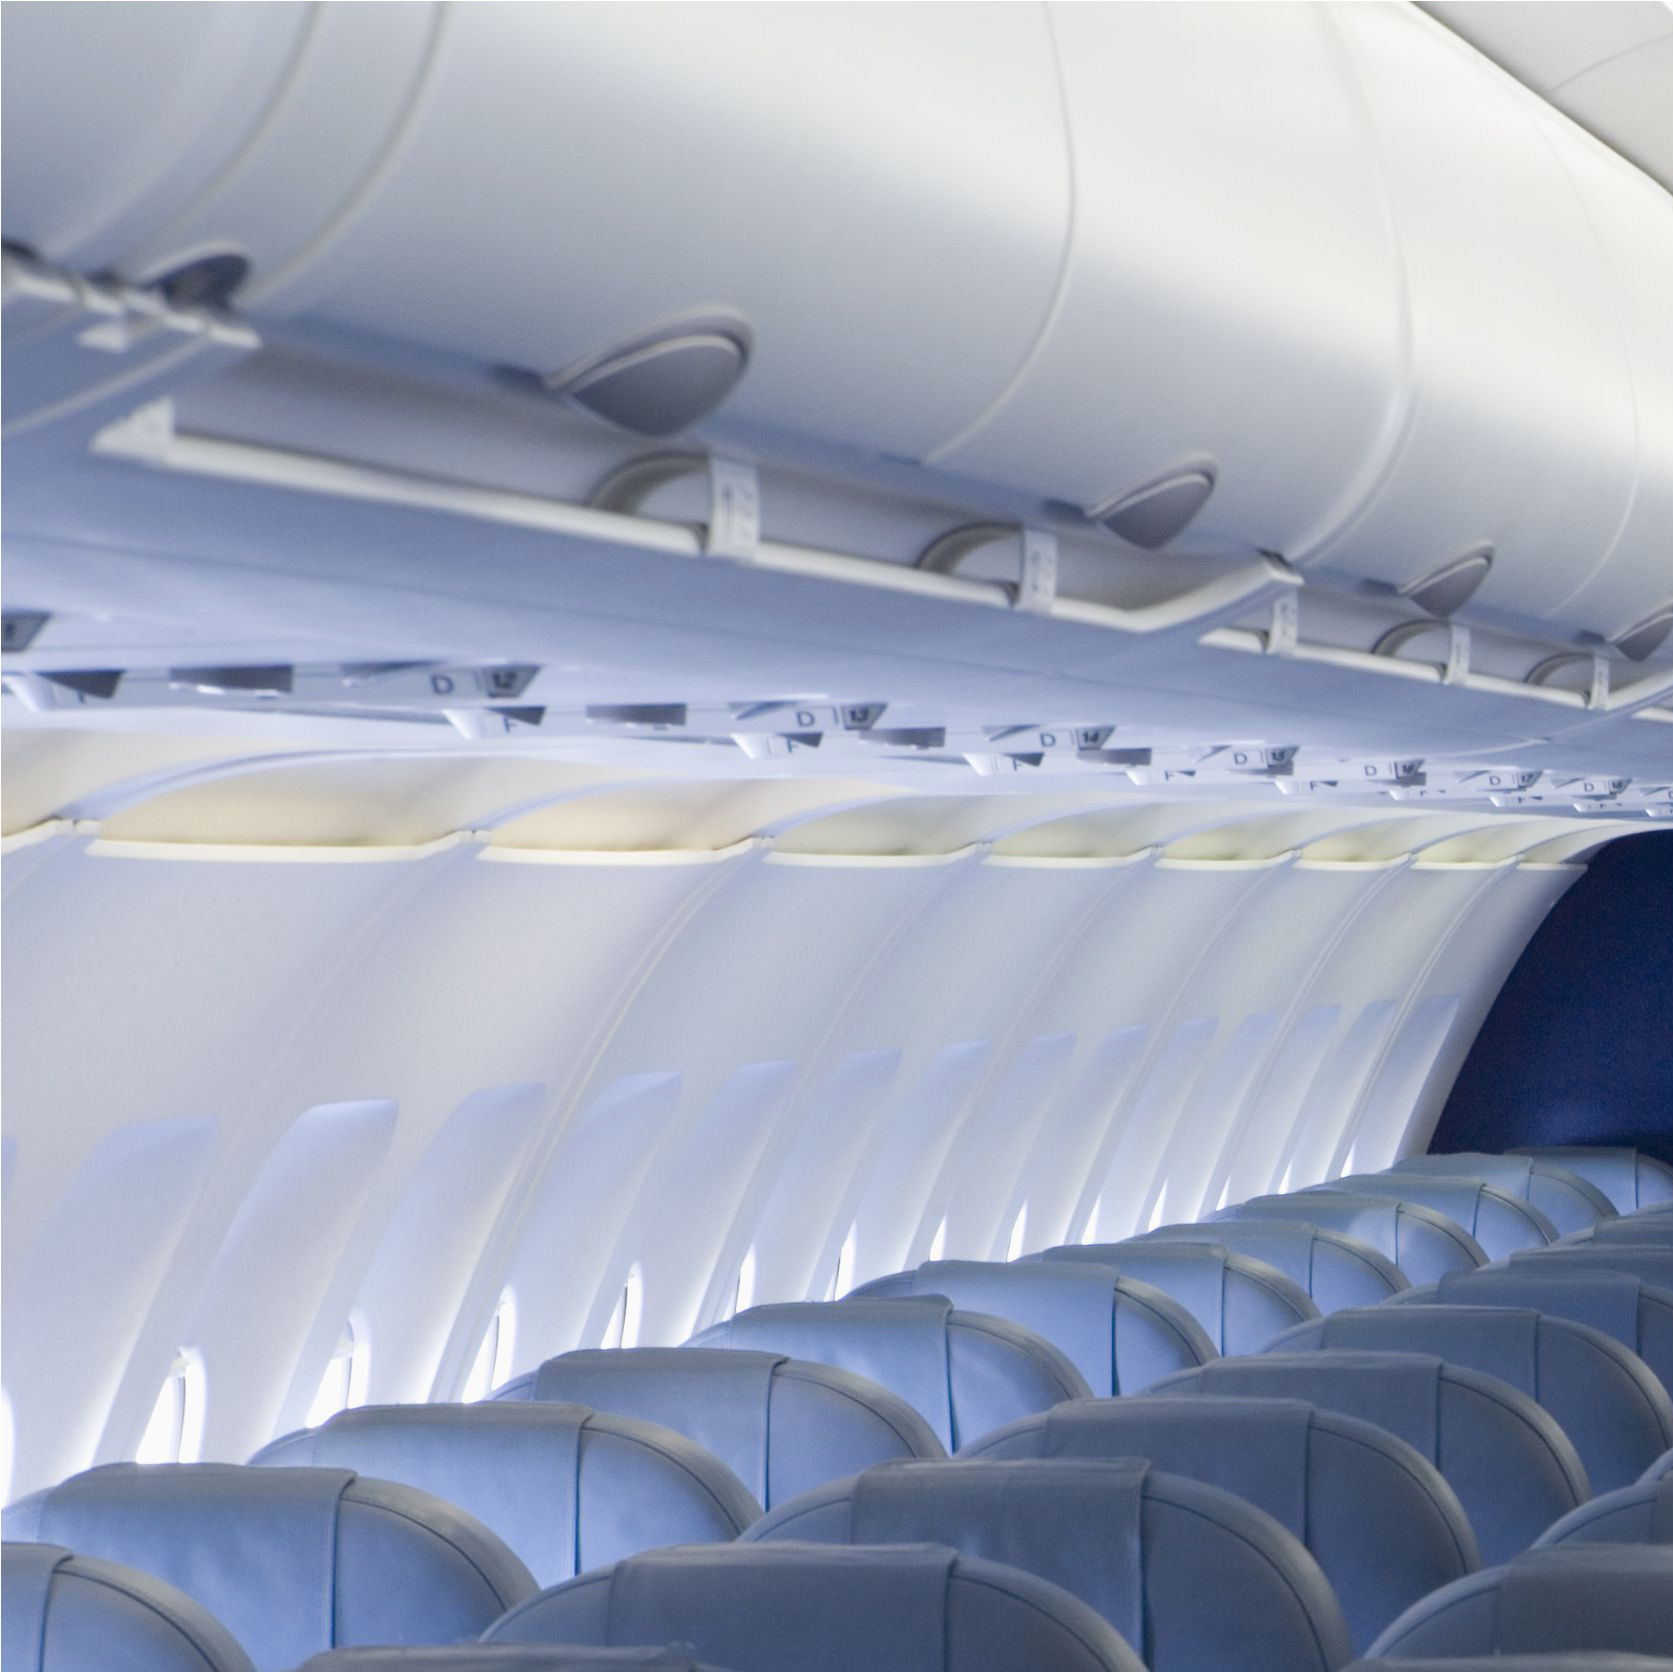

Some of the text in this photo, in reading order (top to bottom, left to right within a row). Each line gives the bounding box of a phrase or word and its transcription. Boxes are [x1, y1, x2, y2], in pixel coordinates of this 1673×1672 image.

[430, 671, 517, 695] D 12
[796, 709, 869, 727] D 13
[1040, 733, 1056, 747] D
[1234, 753, 1248, 765] D
[1364, 765, 1377, 776] D
